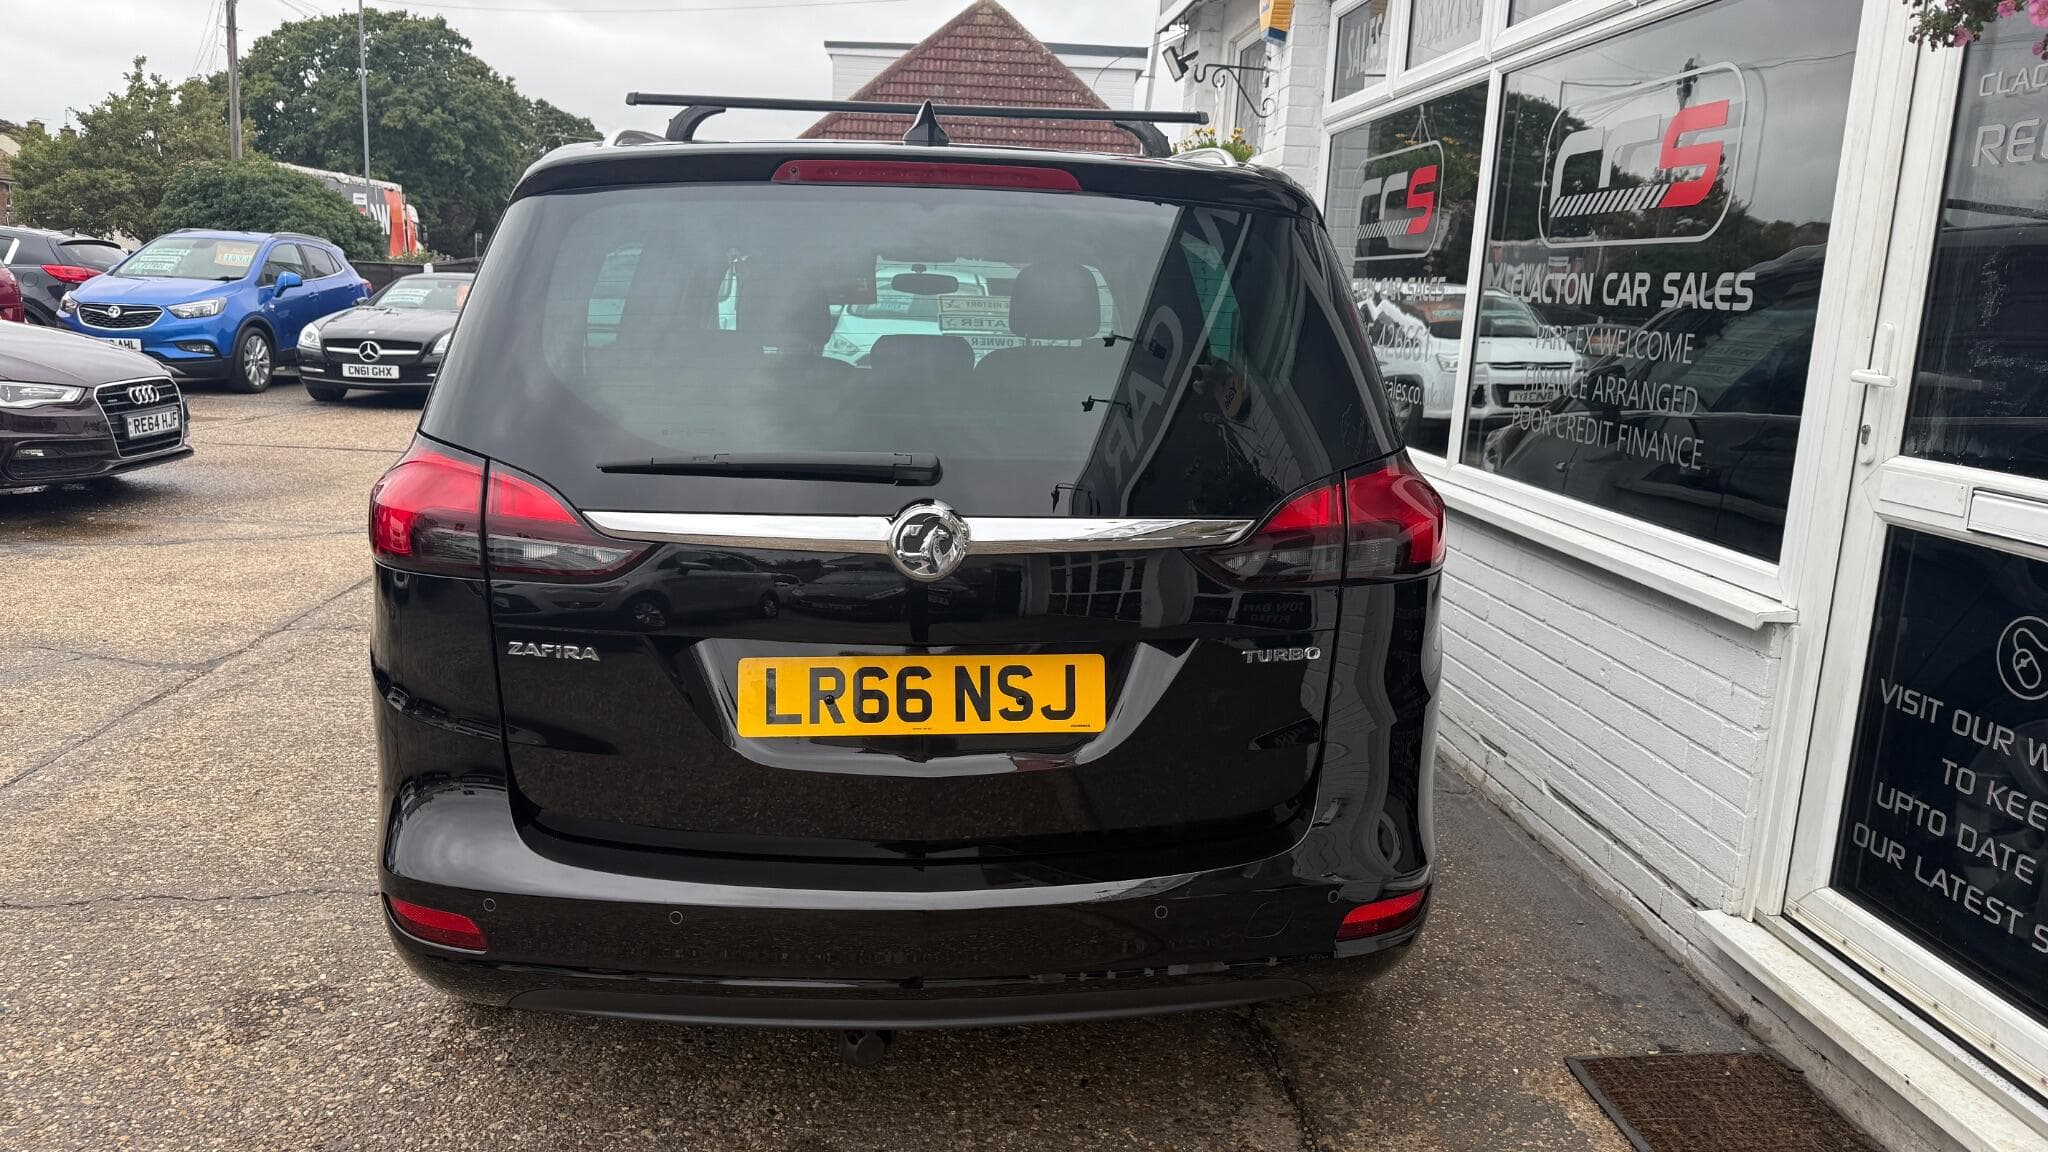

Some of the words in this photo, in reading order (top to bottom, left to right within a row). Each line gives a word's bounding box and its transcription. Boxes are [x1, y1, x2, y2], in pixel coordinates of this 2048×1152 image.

[1405, 276, 1447, 302] SALES
[1510, 271, 1594, 305] CLACTON
[1602, 272, 1651, 308] CAR
[1660, 271, 1756, 312] SALES
[1535, 324, 1572, 352] PART
[1575, 326, 1596, 355] EX
[1599, 328, 1696, 365] WELCOME
[348, 365, 370, 376] CN61
[371, 366, 393, 378] GHX
[1523, 365, 1588, 400] FINANCE
[1591, 374, 1699, 415] ARRANGED
[133, 415, 160, 434] RE64
[162, 411, 177, 428] HJF
[1512, 403, 1552, 435] POOR
[1555, 412, 1614, 449] CREDIT
[1616, 423, 1705, 471] FINANCE
[507, 641, 601, 662] ZAFIRA
[1241, 646, 1321, 664] TURBO
[765, 665, 934, 726] LR66
[954, 664, 1077, 722] NSJ
[1880, 678, 1945, 725] VISIT
[1952, 707, 2016, 757] OUR
[1941, 757, 1977, 797] TO
[1875, 781, 1947, 838] UPTO
[1956, 822, 2037, 886] DATE
[1853, 822, 1907, 872] OUR
[1914, 855, 2024, 936] LATEST
